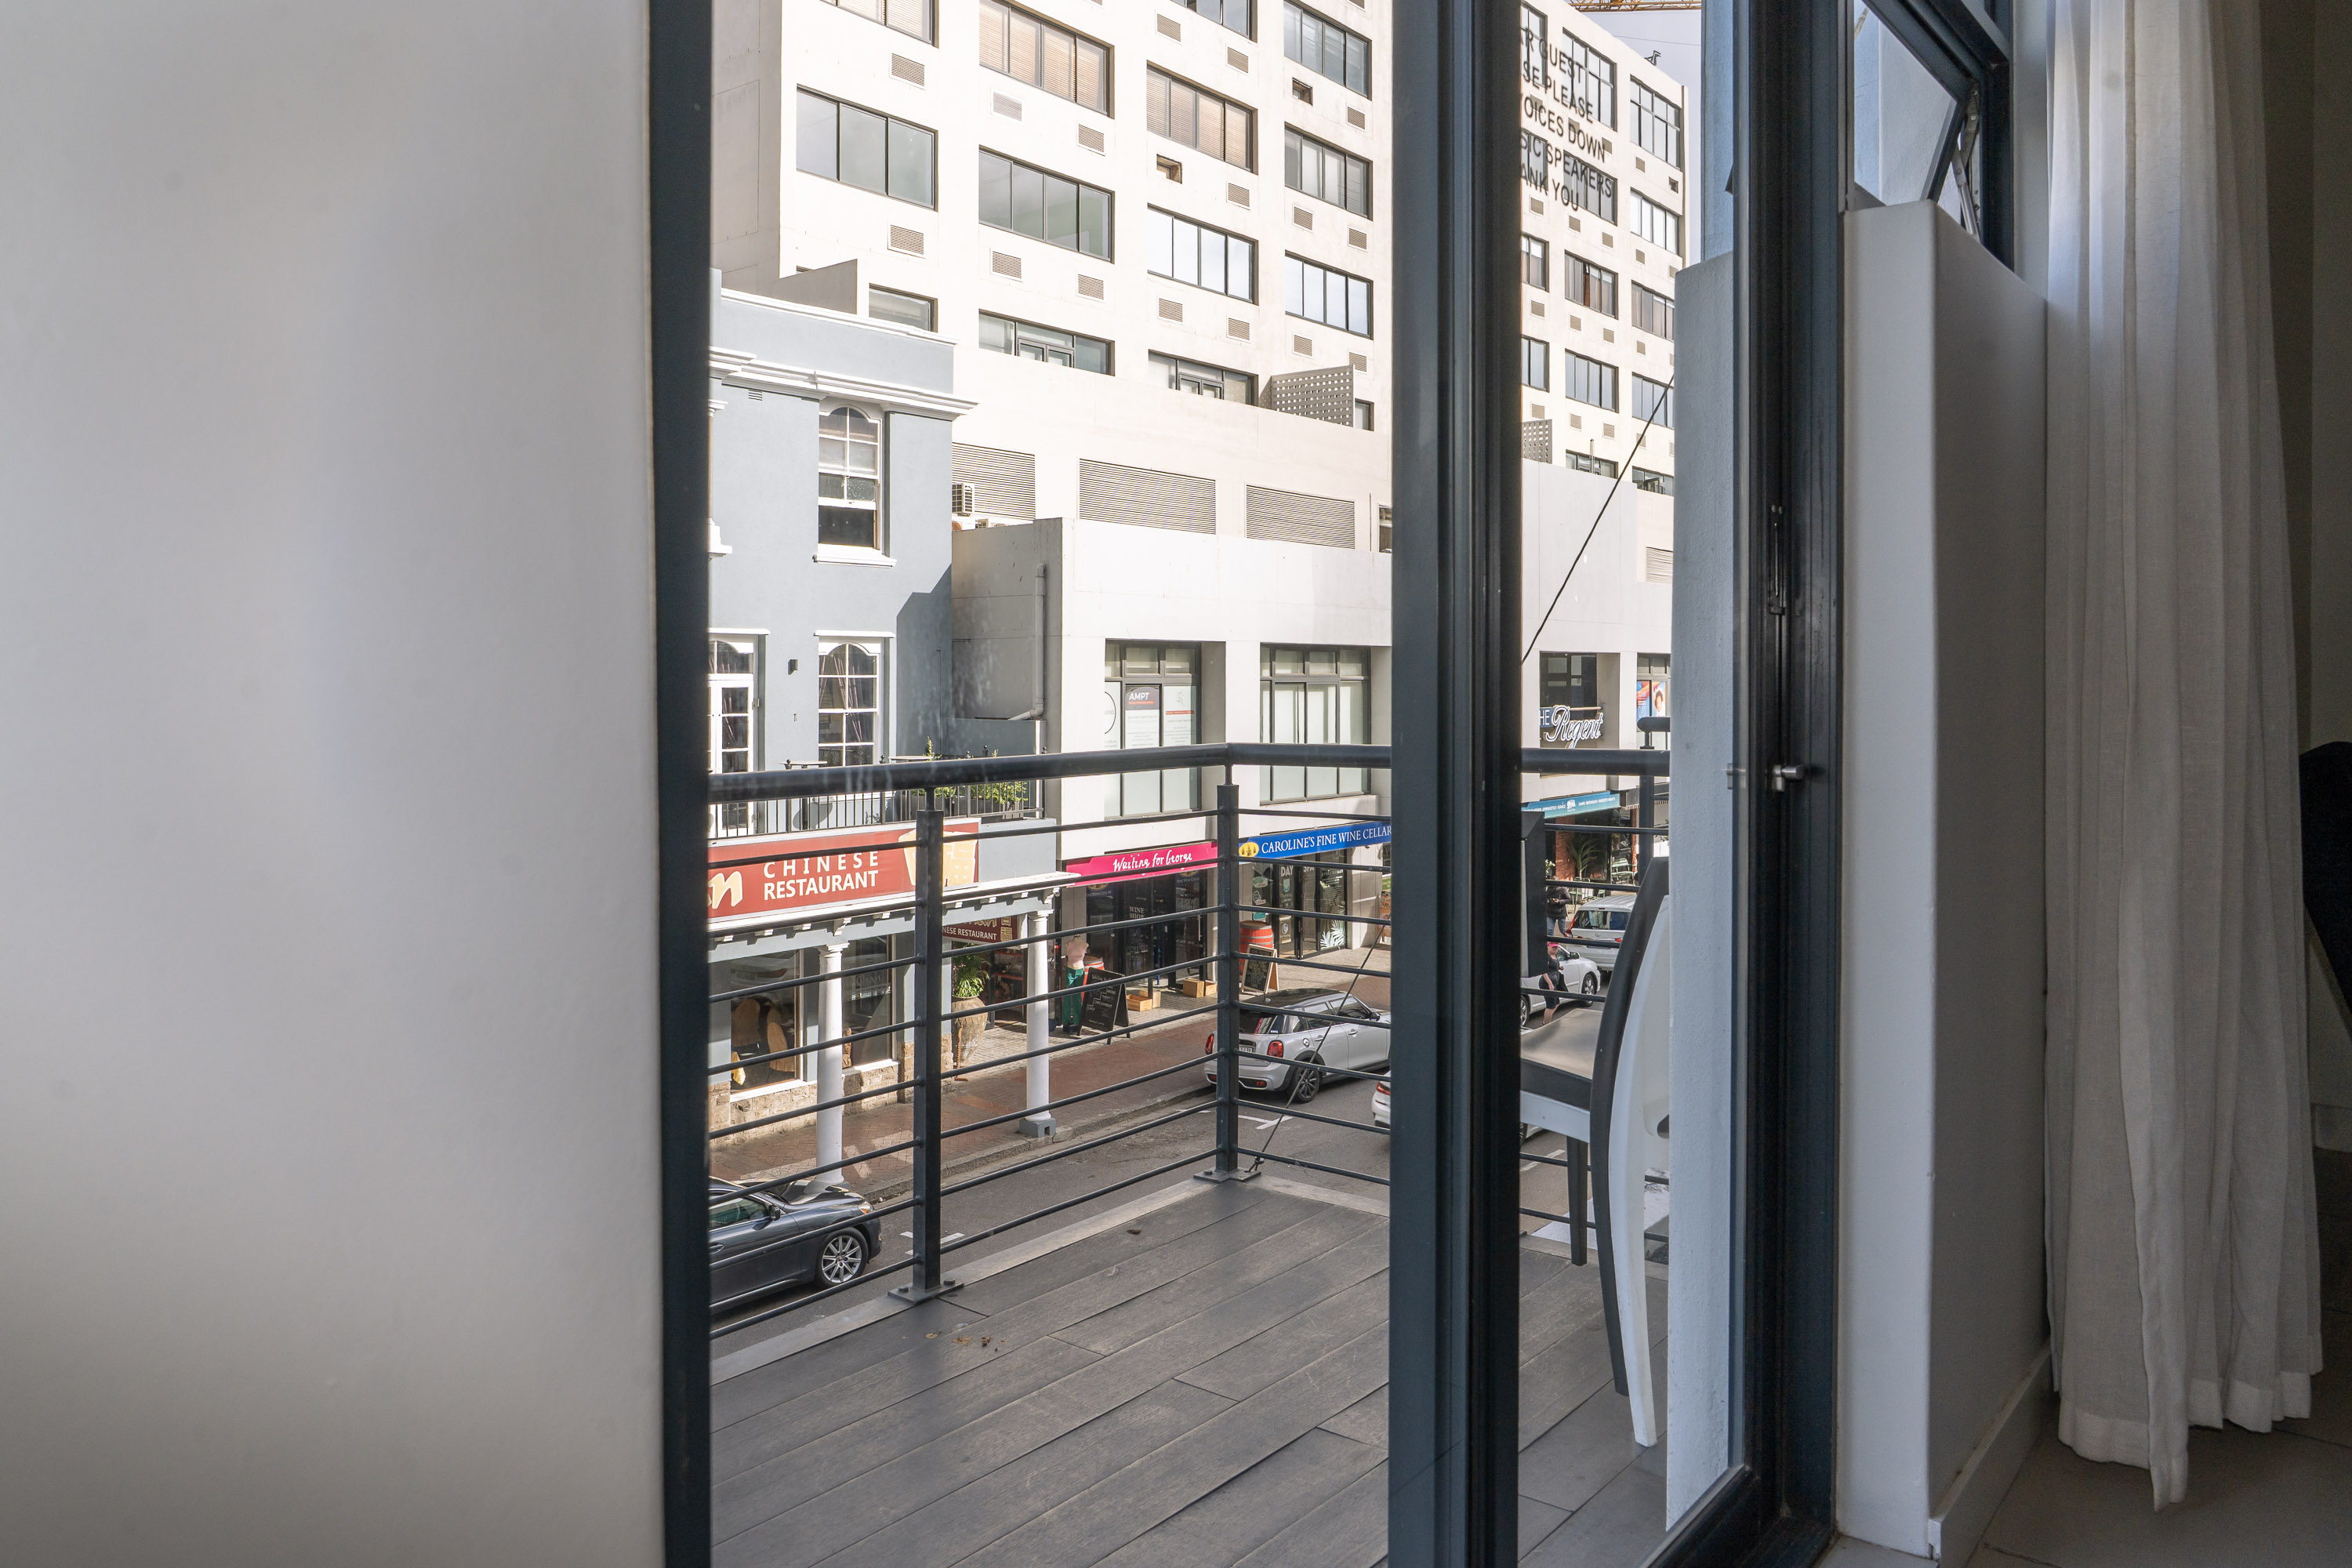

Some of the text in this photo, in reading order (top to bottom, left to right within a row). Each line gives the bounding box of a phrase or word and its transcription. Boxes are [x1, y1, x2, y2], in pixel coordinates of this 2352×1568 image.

[1539, 38, 1584, 84] GUEST
[1544, 74, 1593, 124] PLEASE
[1568, 122, 1605, 163] DOWN
[1547, 143, 1612, 198] SPEAKERS
[1552, 179, 1579, 212] YOU
[1129, 691, 1149, 700] AMPT
[1545, 706, 1603, 749] Regent
[1261, 836, 1315, 854] CAROLINE'S
[1316, 833, 1337, 847] FINE
[1338, 830, 1361, 843] WINE
[764, 851, 879, 879] CHINESE
[1113, 849, 1192, 876] Waiting for George
[1280, 865, 1294, 877] DAY
[764, 869, 879, 901] RESTAURANT
[957, 927, 997, 941] RESTAURANT
